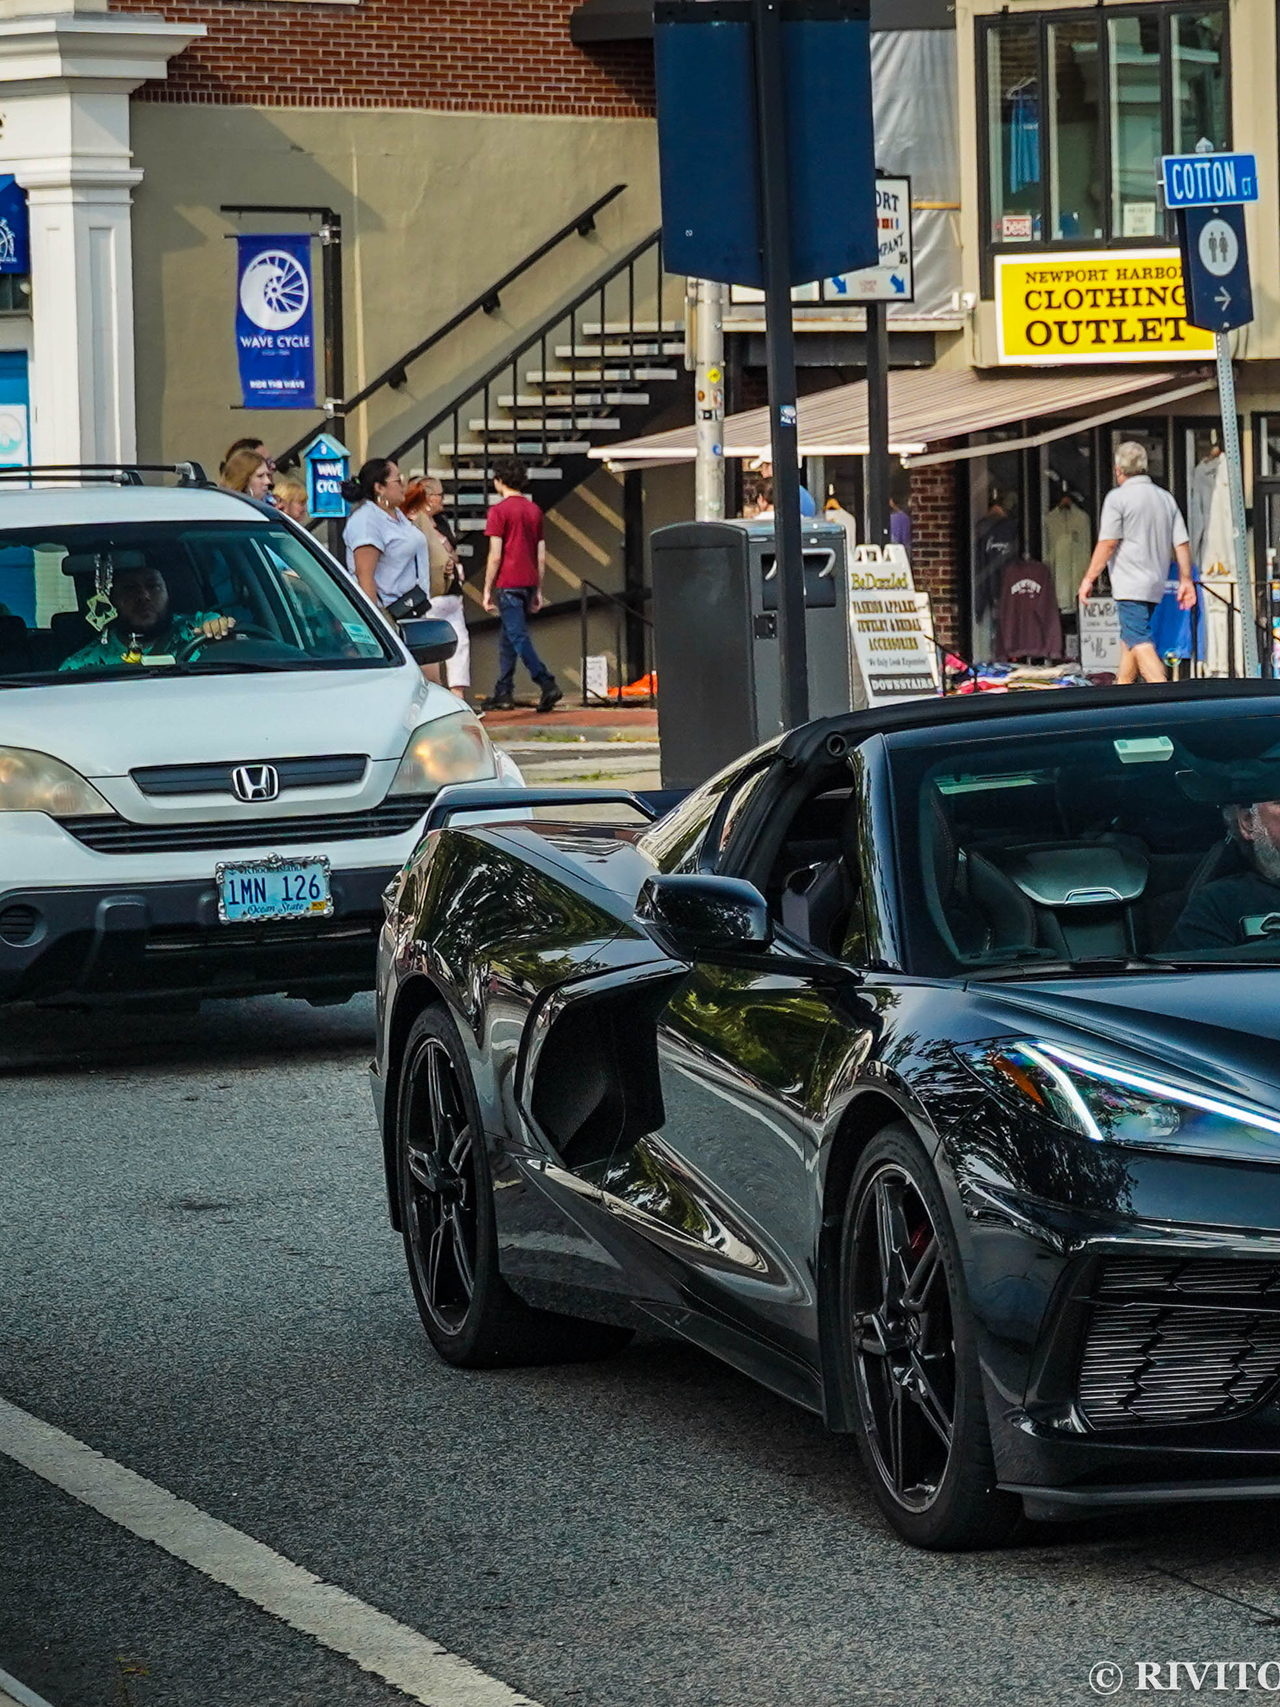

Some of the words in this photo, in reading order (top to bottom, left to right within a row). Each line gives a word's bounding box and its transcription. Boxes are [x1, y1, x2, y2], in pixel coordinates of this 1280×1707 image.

[1172, 161, 1237, 200] COTTON
[1241, 177, 1252, 196] CT
[1025, 269, 1109, 284] NEWPORT
[1024, 285, 1186, 311] CLOTHING
[240, 335, 274, 348] WAVE
[276, 335, 311, 348] CYCLE
[1025, 317, 1187, 346] OUTLET
[316, 463, 342, 477] WAVE
[228, 877, 266, 905] 1MN
[281, 874, 320, 901] 126
[247, 905, 275, 915] Ocean
[278, 901, 304, 914] State
